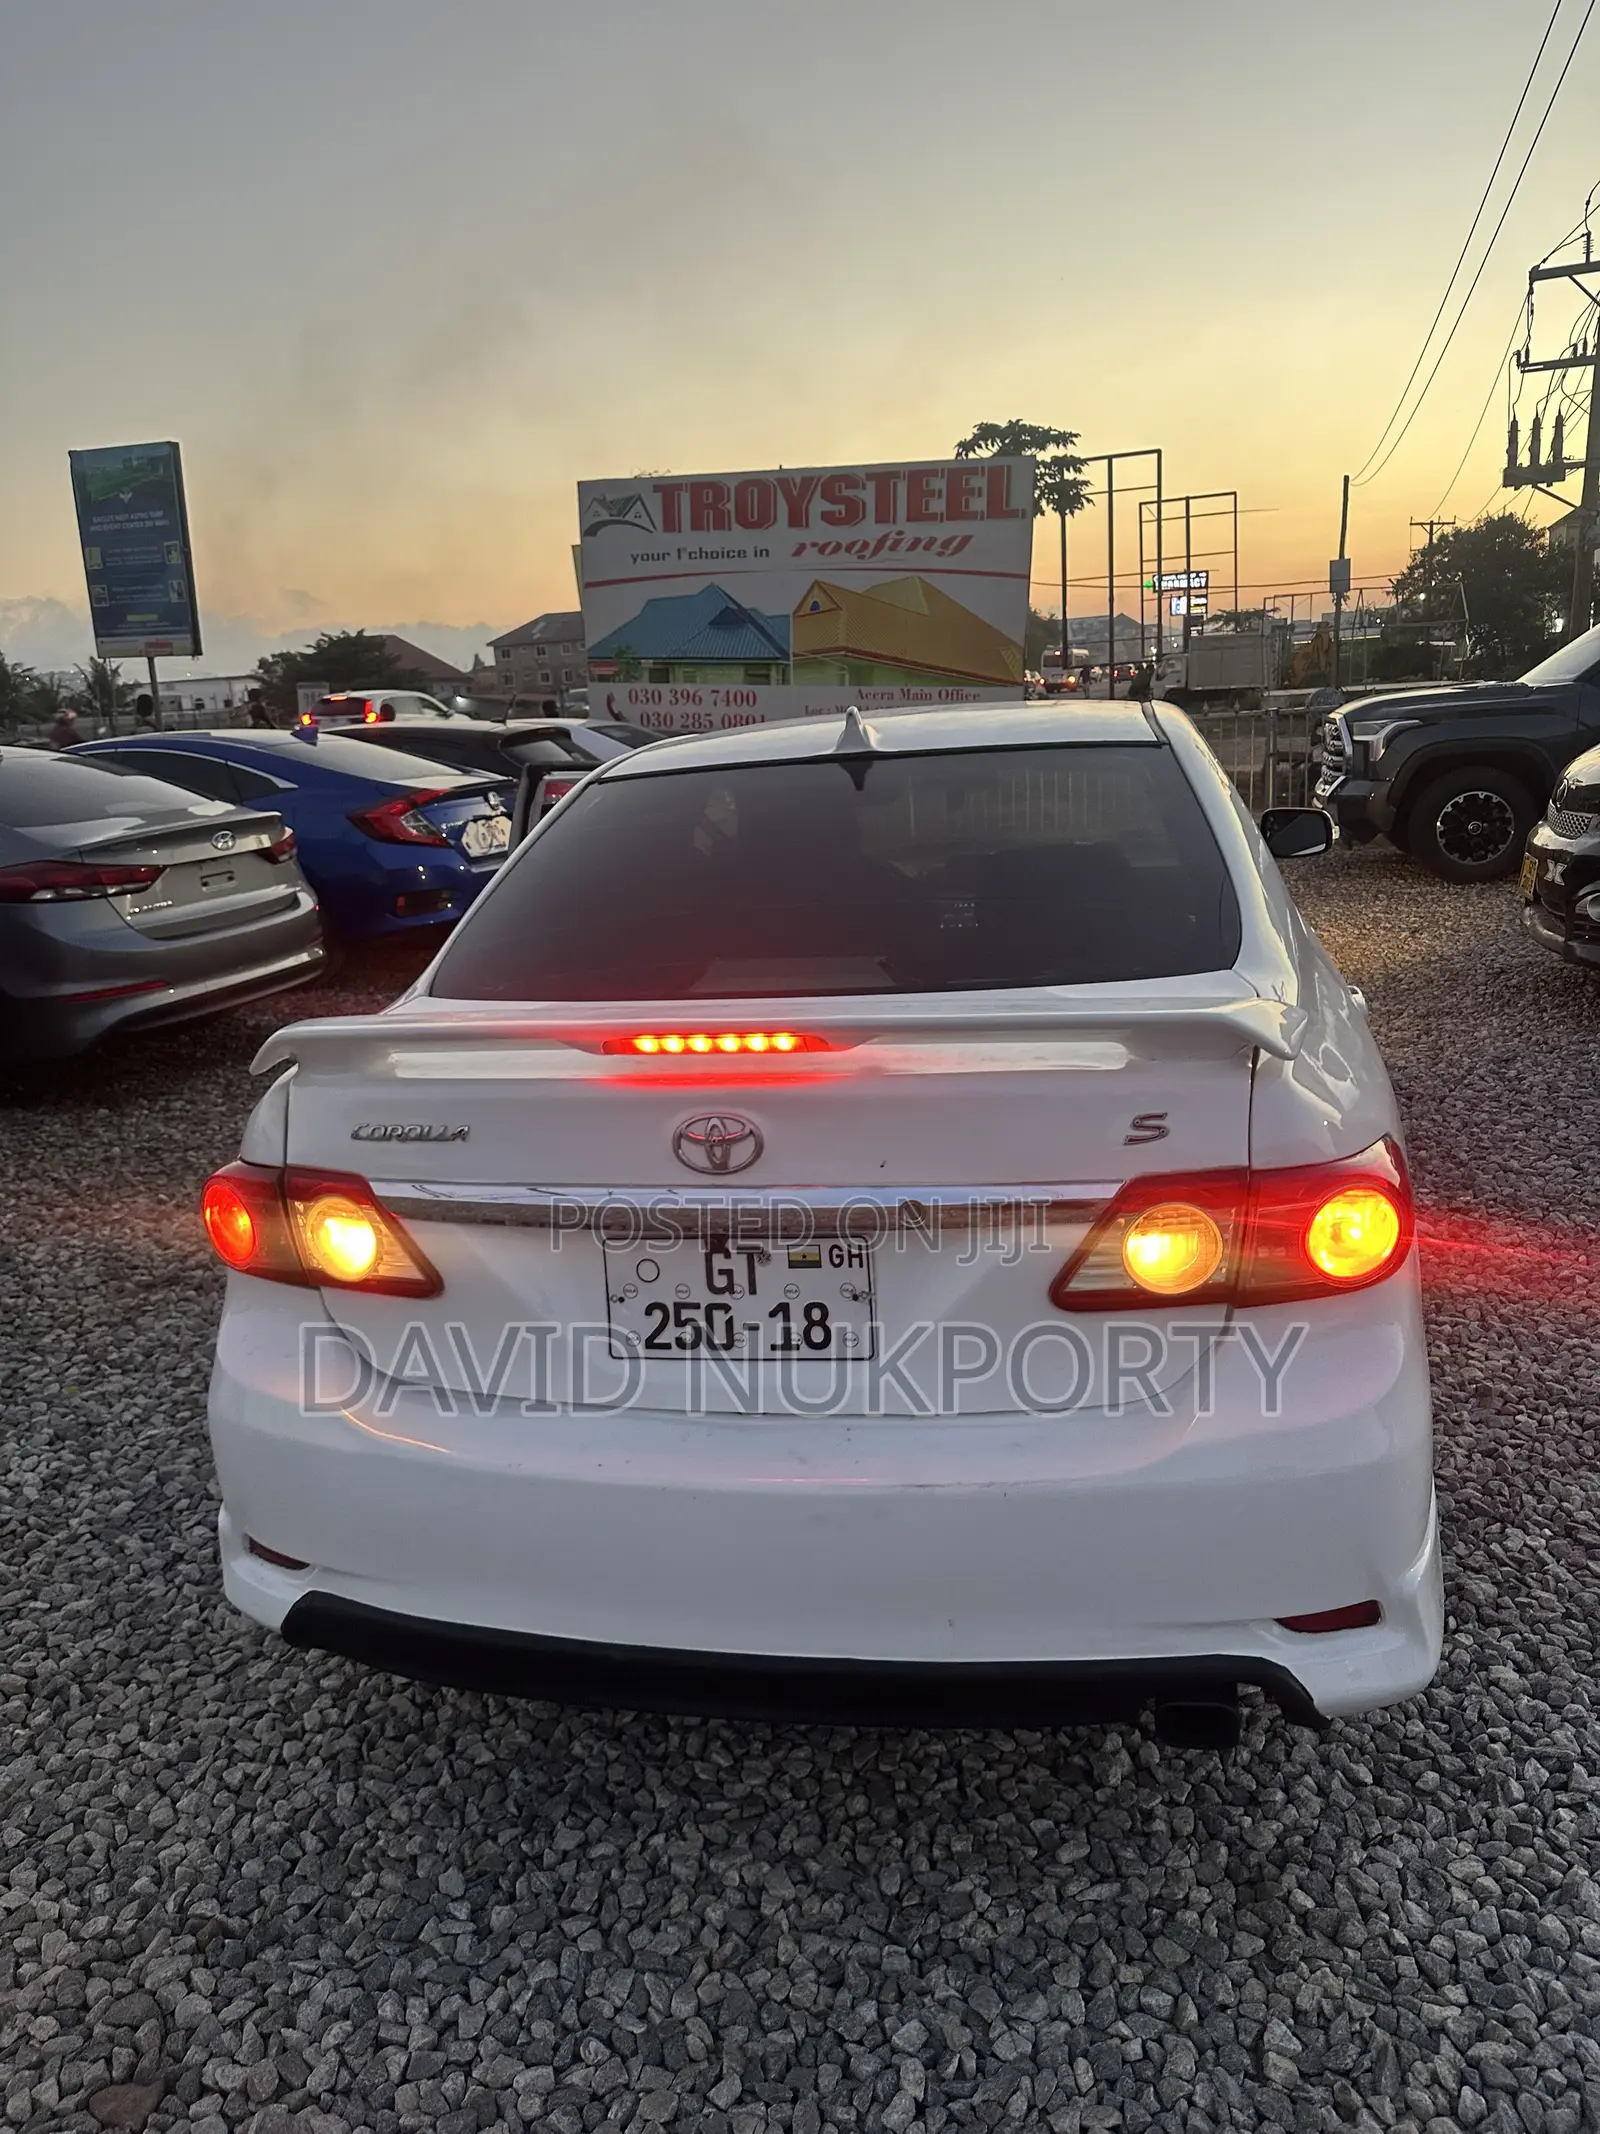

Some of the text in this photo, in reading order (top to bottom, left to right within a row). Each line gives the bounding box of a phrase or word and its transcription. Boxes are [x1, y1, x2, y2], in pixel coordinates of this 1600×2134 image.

[653, 464, 1026, 533] TROYSTEEL
[630, 551, 671, 565] your
[688, 546, 748, 560] choice
[754, 545, 770, 558] in
[791, 530, 974, 560] roofing
[628, 688, 757, 707] 030 396 7400
[856, 687, 981, 701] Accra Main Office
[640, 711, 674, 728] 030
[680, 712, 713, 729] 285
[351, 1124, 469, 1142] COROLLA
[1123, 1112, 1170, 1146] S
[705, 1244, 864, 1295] GT GH
